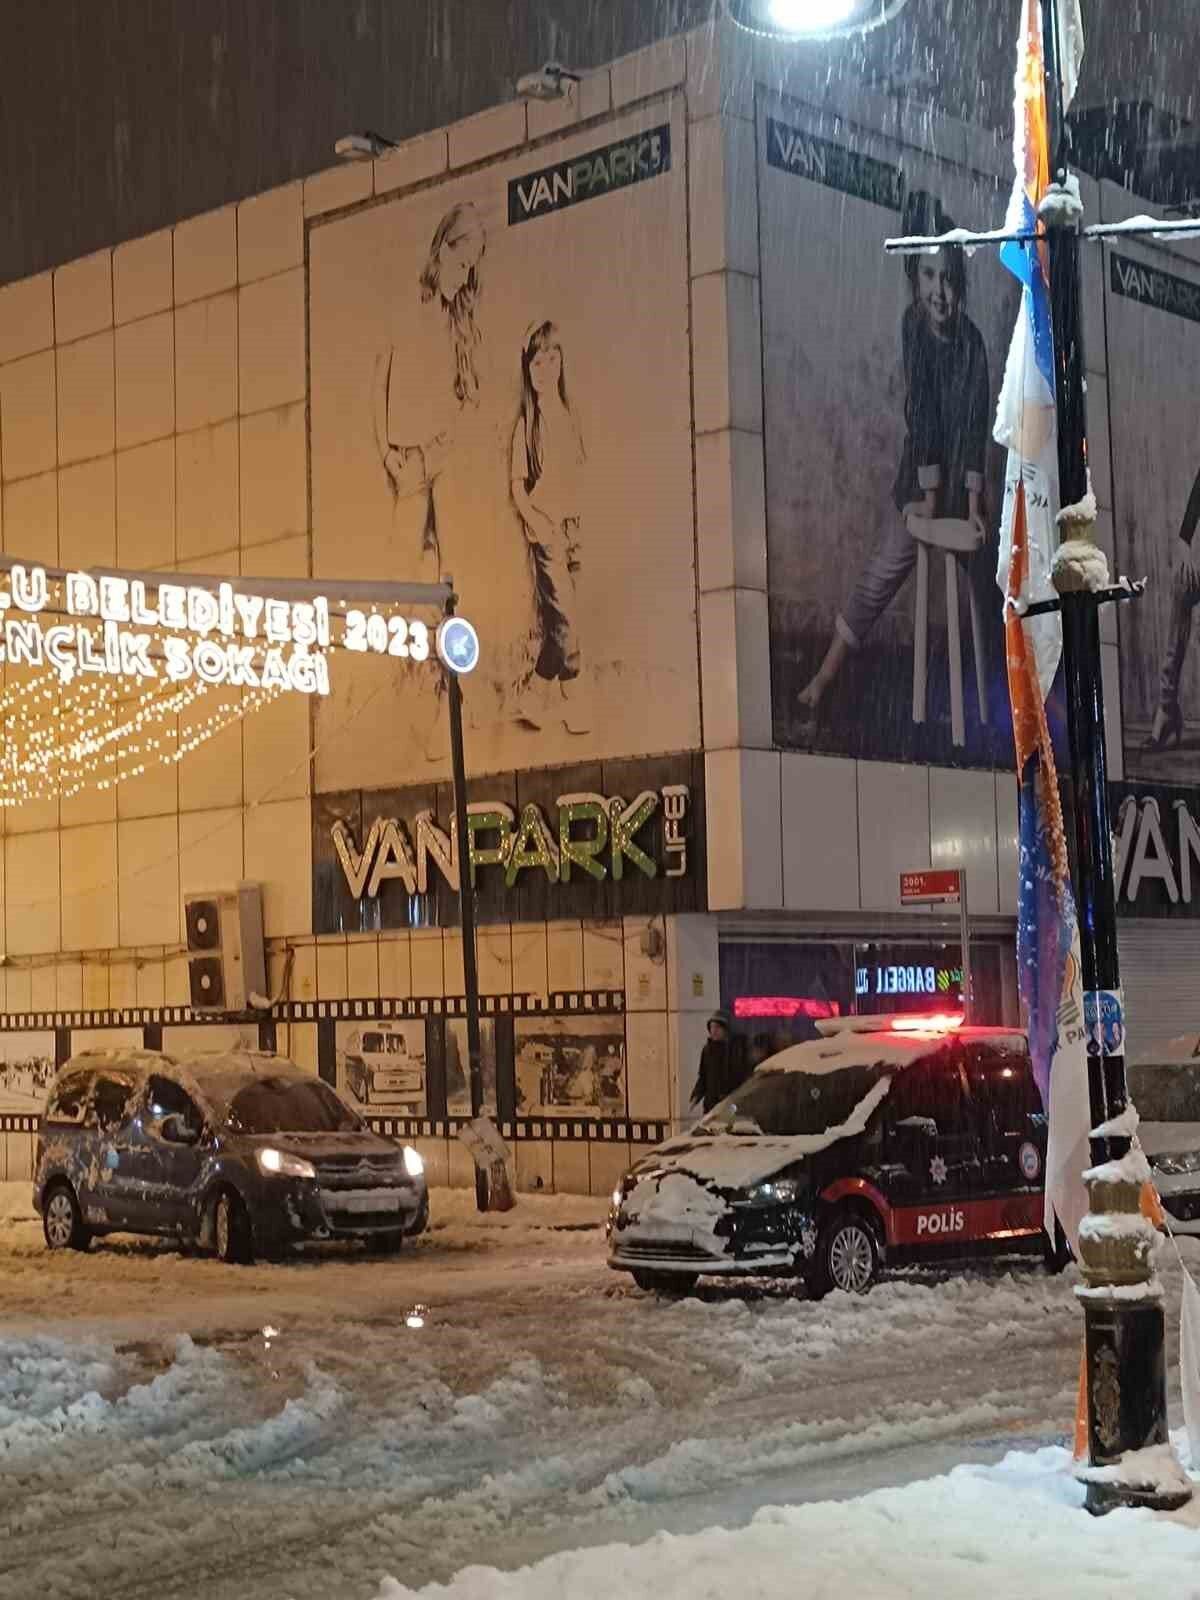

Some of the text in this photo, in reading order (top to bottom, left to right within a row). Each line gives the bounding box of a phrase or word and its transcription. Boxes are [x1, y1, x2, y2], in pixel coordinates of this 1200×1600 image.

[517, 137, 651, 213] VANPARK
[0, 620, 158, 685] NÇLİK
[65, 571, 330, 646] BELEDİYESİ
[345, 609, 430, 661] 2023
[331, 790, 659, 899] VANPARK
[917, 1206, 965, 1235] POLİS
